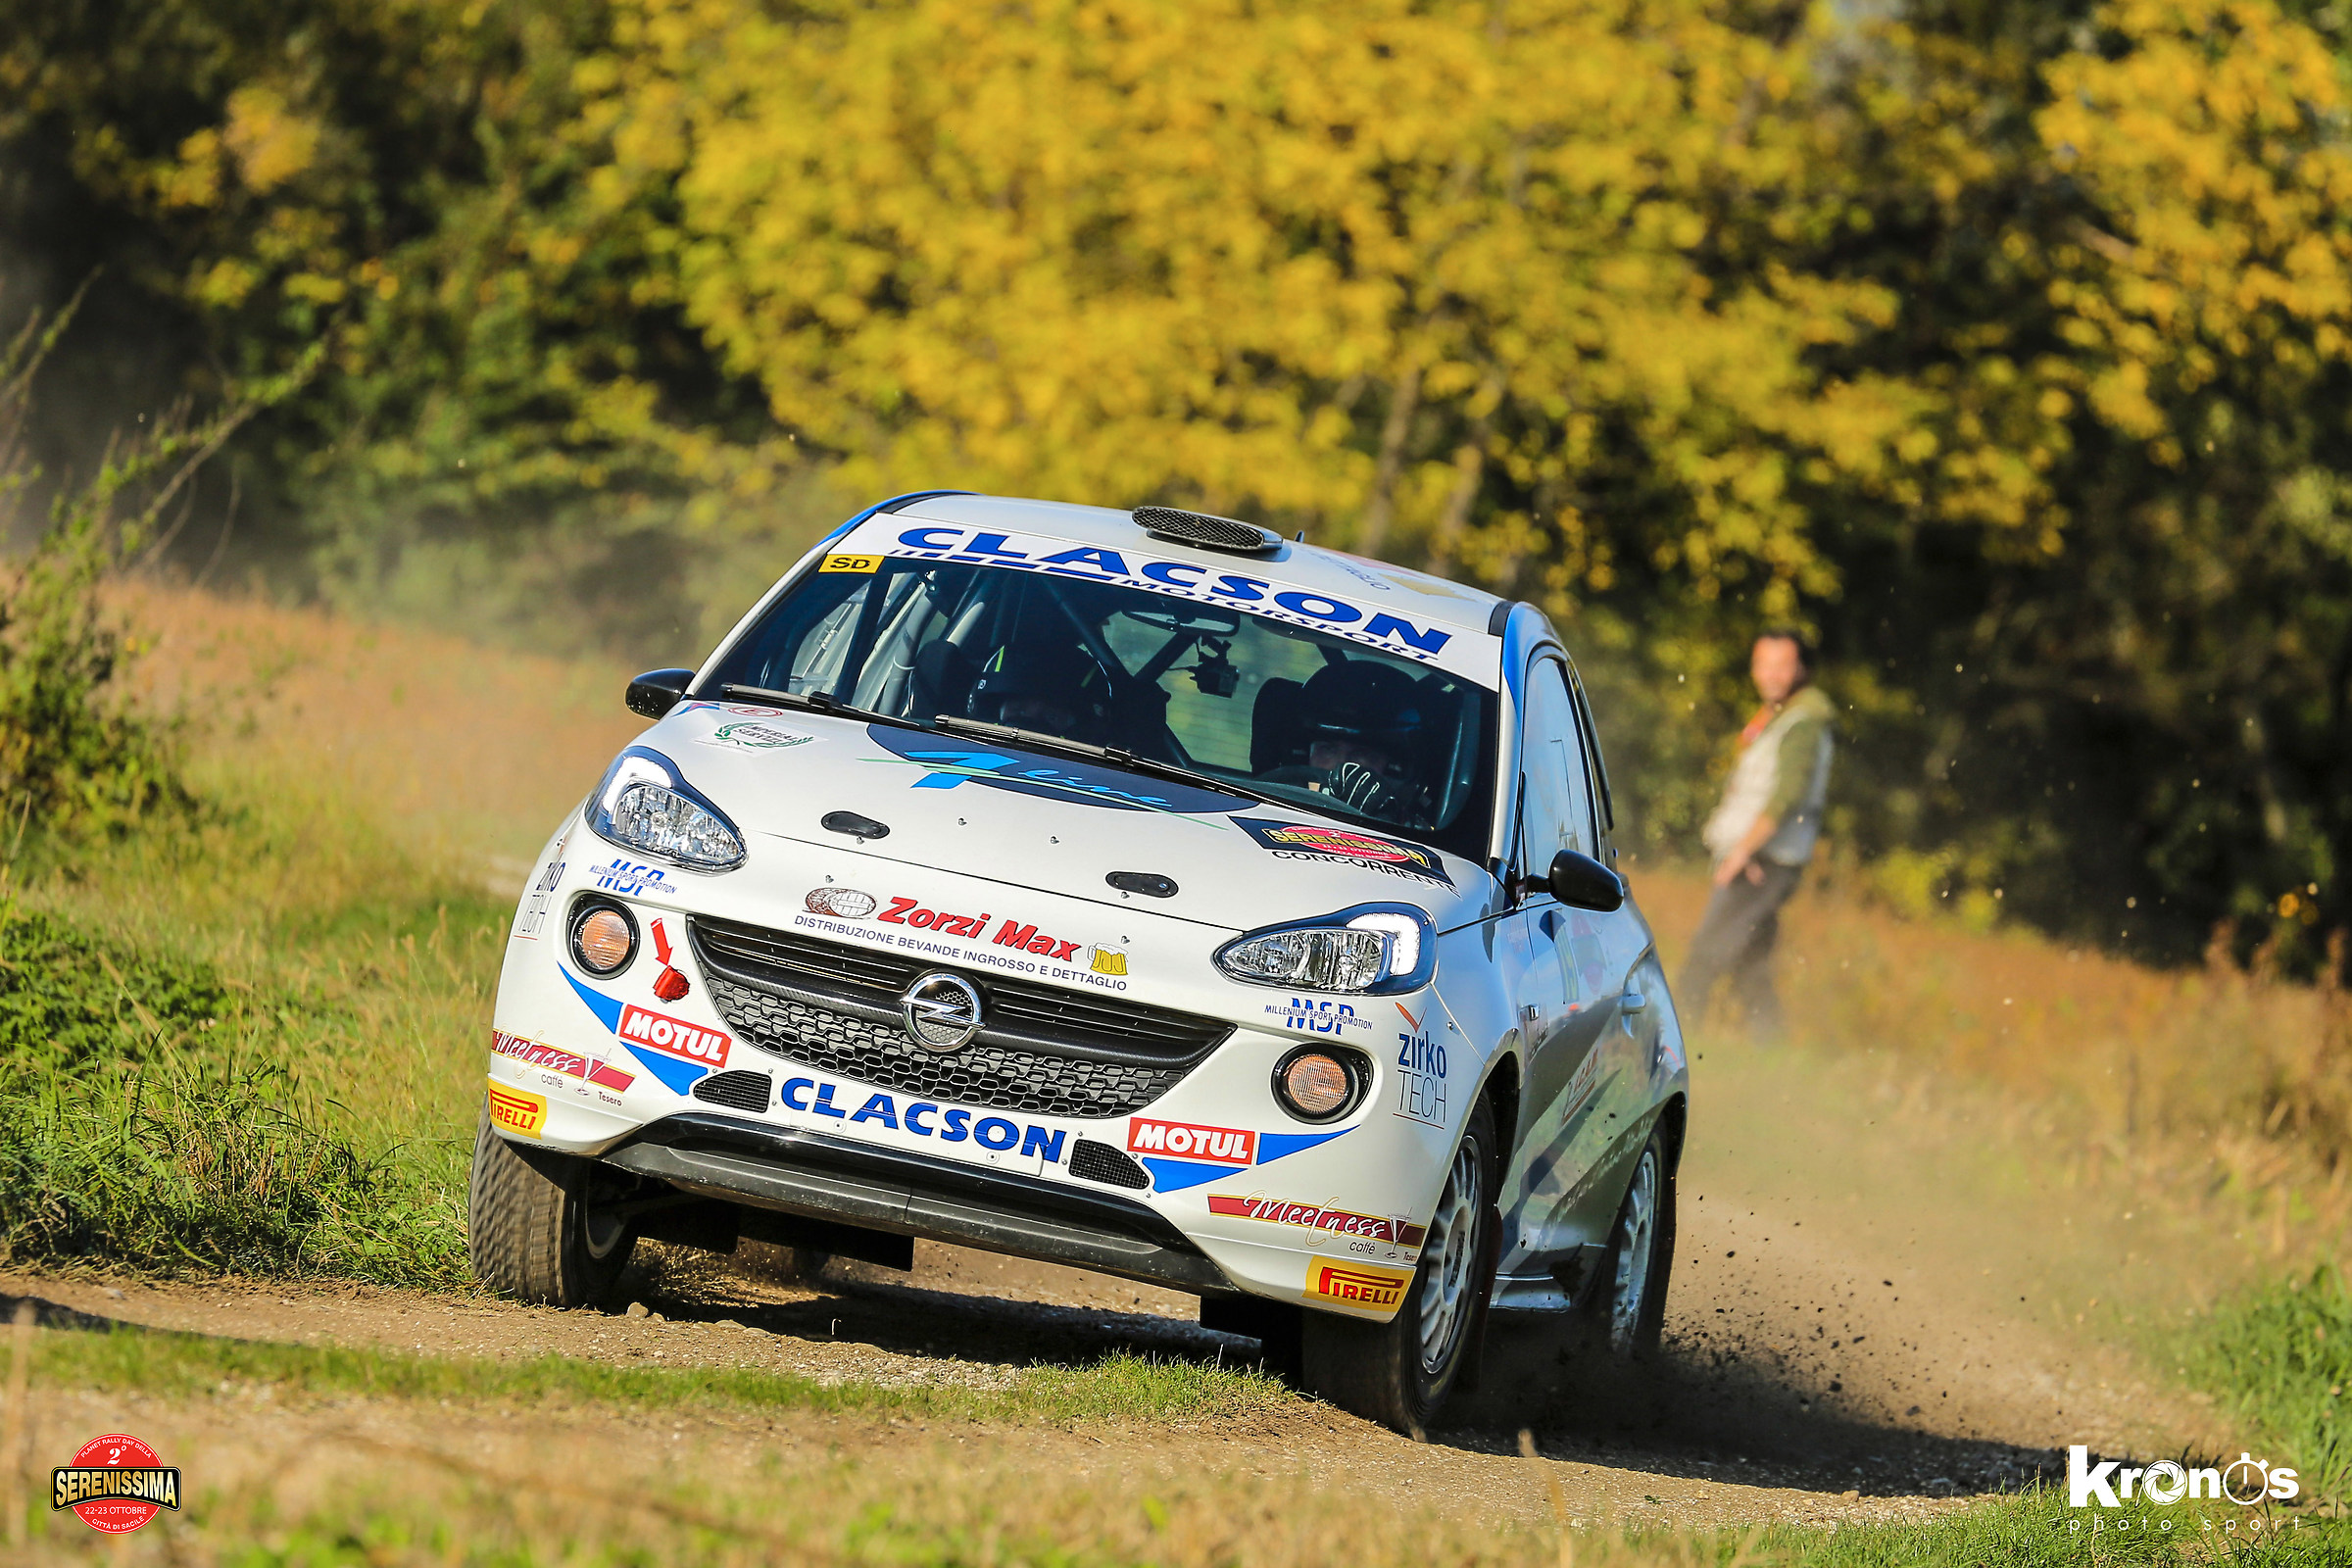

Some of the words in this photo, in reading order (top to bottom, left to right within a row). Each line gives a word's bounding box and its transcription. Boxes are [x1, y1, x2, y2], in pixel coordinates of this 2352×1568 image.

[829, 557, 871, 570] SD
[898, 527, 1452, 655] CLACSON
[1122, 579, 1439, 662] MOTORSPORT
[1270, 829, 1428, 867] SERENISSIMA
[639, 875, 678, 894] PROMOTION
[1271, 850, 1461, 899] CONCORRENTE
[794, 914, 894, 945] DISTRIBUZIONE
[898, 937, 960, 958] BEVANDE
[963, 951, 1036, 973] INGROSSO
[1040, 964, 1048, 975] E
[1052, 967, 1127, 991] DETTAGLIO
[877, 896, 991, 939] Zorzi
[992, 919, 1081, 962] Max
[623, 1010, 725, 1062] MOTUL
[1264, 1004, 1307, 1018] MILLENIUM
[1309, 1008, 1332, 1021] SPORT
[1334, 1013, 1373, 1030] PROMOTION
[1287, 998, 1354, 1035] MSP
[1397, 1030, 1447, 1079] zirko
[490, 1089, 540, 1131] PIRELLI
[597, 1090, 623, 1107] Tesero
[781, 1077, 1067, 1163] CLACSON
[1396, 1069, 1446, 1122] TECH
[1132, 1122, 1250, 1159] MOTUL
[1243, 1189, 1386, 1248] Meetness
[1319, 1265, 1404, 1305] PIRELLI
